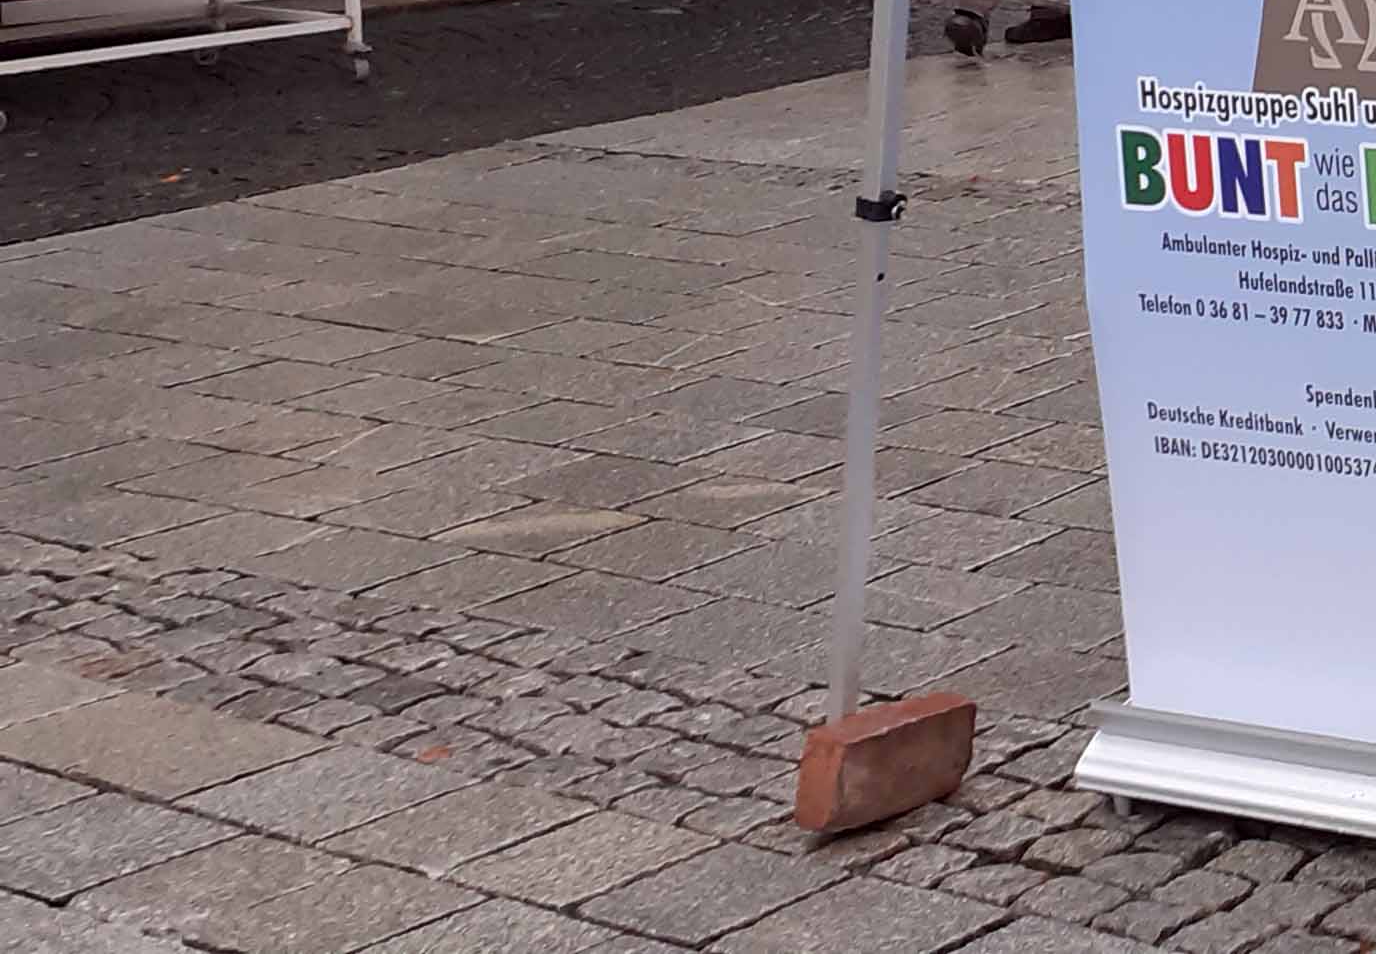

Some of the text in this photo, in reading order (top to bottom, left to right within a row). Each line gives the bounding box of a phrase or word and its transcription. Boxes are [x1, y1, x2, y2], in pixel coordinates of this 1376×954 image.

[1140, 79, 1298, 121] Hospizgruppe
[1306, 91, 1355, 123] Suhl
[1121, 129, 1305, 218] BUNT
[1313, 151, 1355, 178] wie
[1317, 183, 1358, 214] das
[1162, 233, 1247, 258] Ambulanter
[1251, 241, 1307, 265] Hospiz-
[1313, 247, 1340, 267] und
[1239, 271, 1353, 300] Hufelandstraße
[1360, 281, 1376, 302] 11
[1139, 293, 1192, 317] Telefon
[1196, 298, 1205, 318] 0
[1208, 300, 1228, 320] 36
[1232, 301, 1250, 321] 81
[1269, 305, 1288, 326] 39
[1292, 307, 1311, 328] 77
[1316, 309, 1344, 331] 833
[1147, 402, 1215, 427] Deutsche
[1219, 409, 1304, 436] Kreditbank
[1154, 436, 1197, 459] IBAN:
